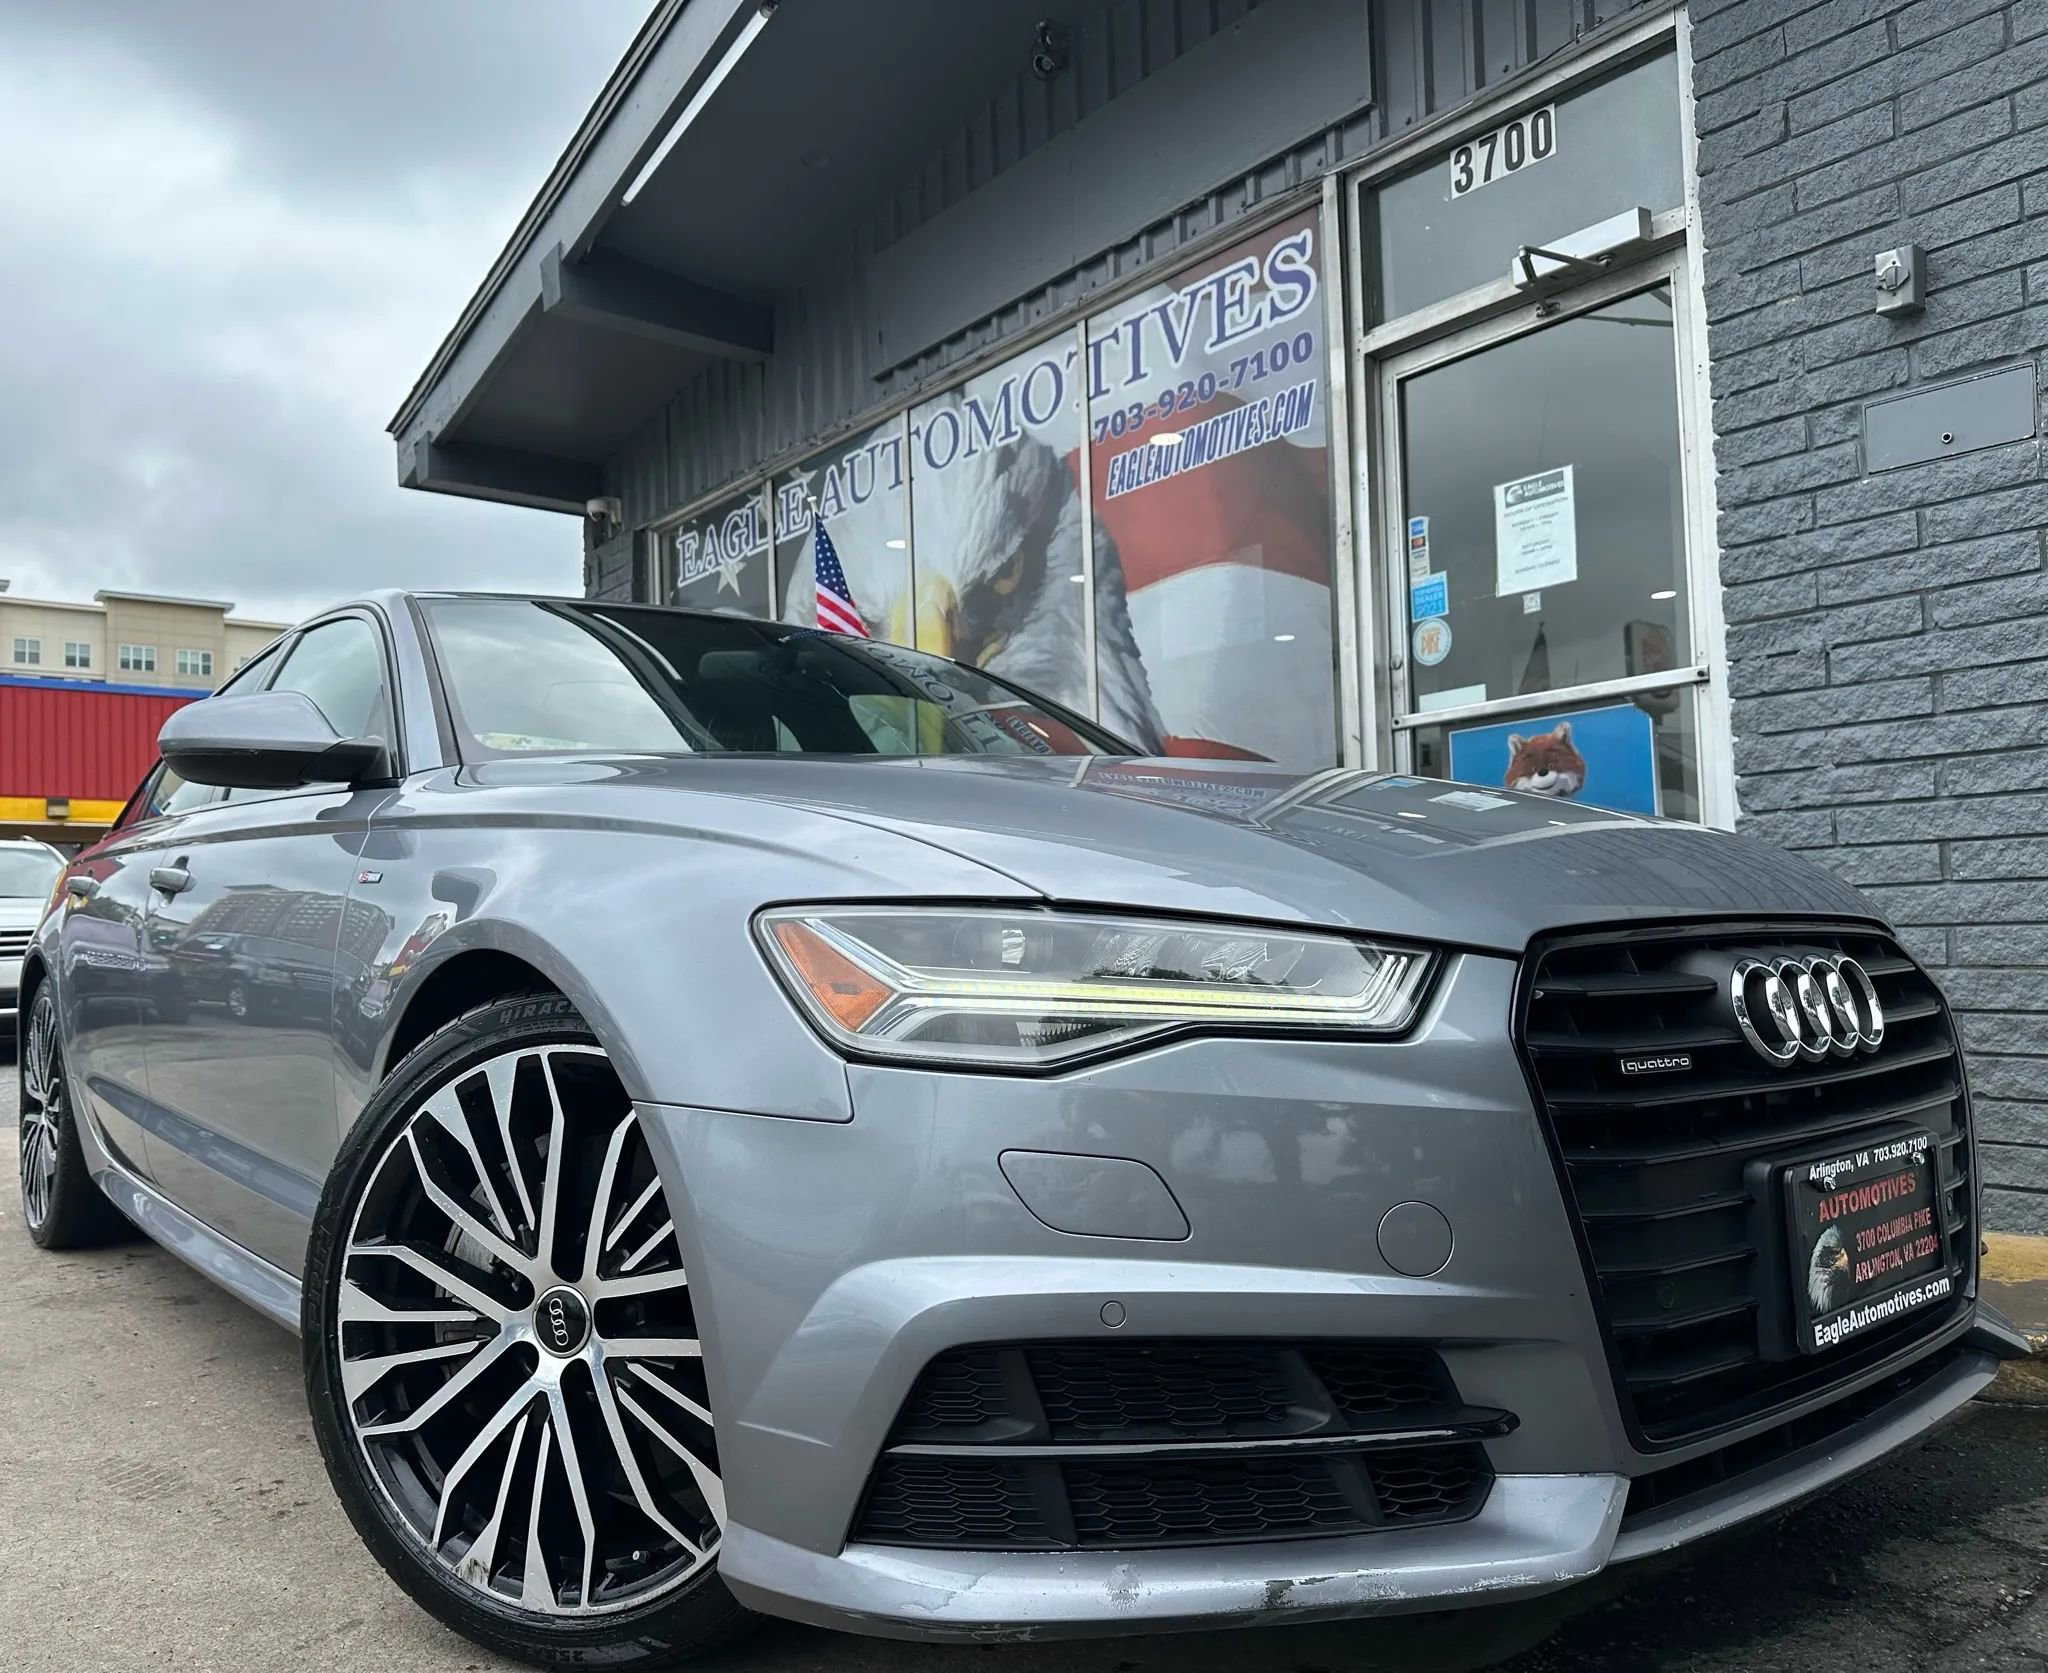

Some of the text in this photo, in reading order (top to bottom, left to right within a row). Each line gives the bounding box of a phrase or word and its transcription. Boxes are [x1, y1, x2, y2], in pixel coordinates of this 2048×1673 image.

[1453, 109, 1553, 194] 3700
[676, 228, 1317, 588] EAGLE AUTOMOTIVES
[1094, 331, 1314, 444] 703-920-7100
[1105, 379, 1317, 500] EAGLEAUTOMOTIVES.COM
[1626, 1057, 1690, 1072] quattro
[1809, 1136, 1928, 1181] Arlington, VA 703.920.7100
[1819, 1171, 1917, 1223] AUTOMOTIVES
[1856, 1207, 1932, 1252] 3700 COLUMBIA PIKE
[1855, 1247, 1904, 1283] ARLINGTON,
[1903, 1243, 1915, 1263] VA
[1814, 1277, 1950, 1347] EagleAutomotives.com
